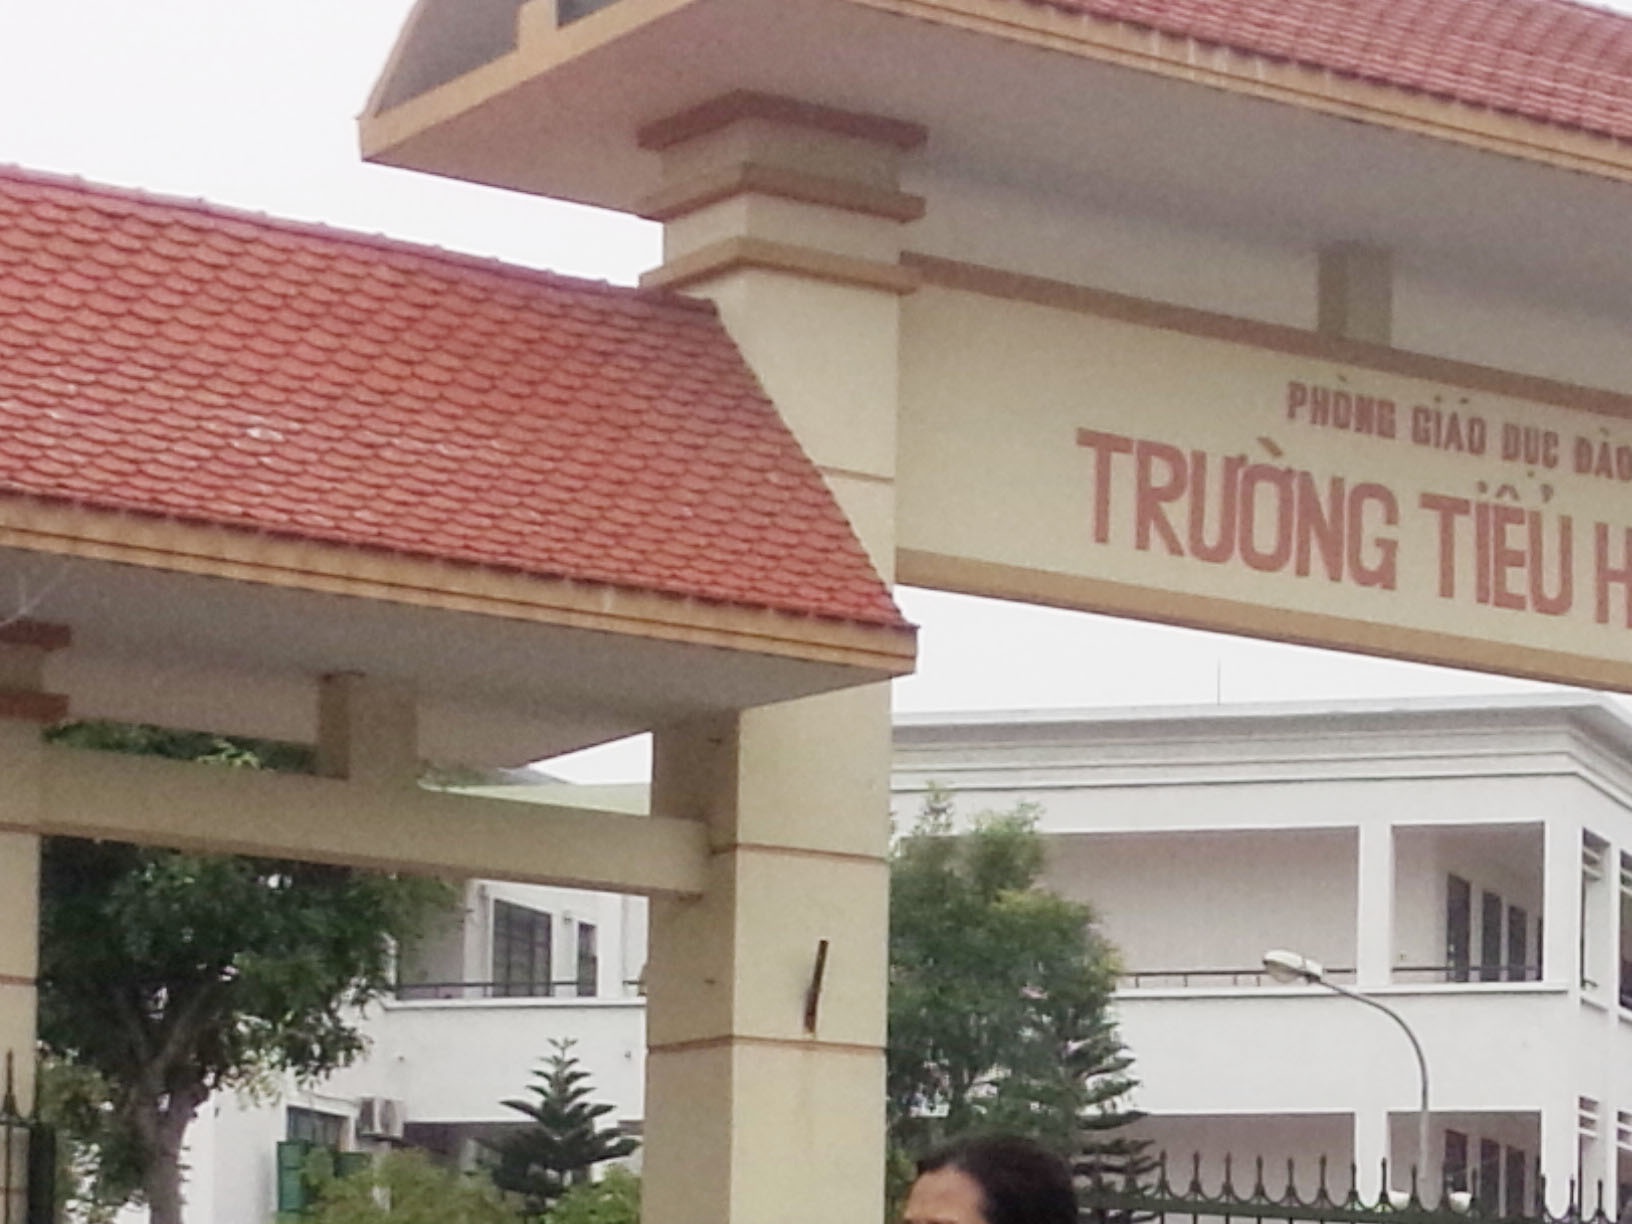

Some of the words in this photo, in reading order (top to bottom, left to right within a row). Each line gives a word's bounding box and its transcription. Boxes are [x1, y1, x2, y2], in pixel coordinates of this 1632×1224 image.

[1287, 374, 1397, 439] PHÒNG
[1411, 395, 1487, 456] GIÁO
[1501, 422, 1559, 478] DỤC
[1076, 427, 1399, 590] TRƯỜNG
[1418, 480, 1573, 617] TIỂU
